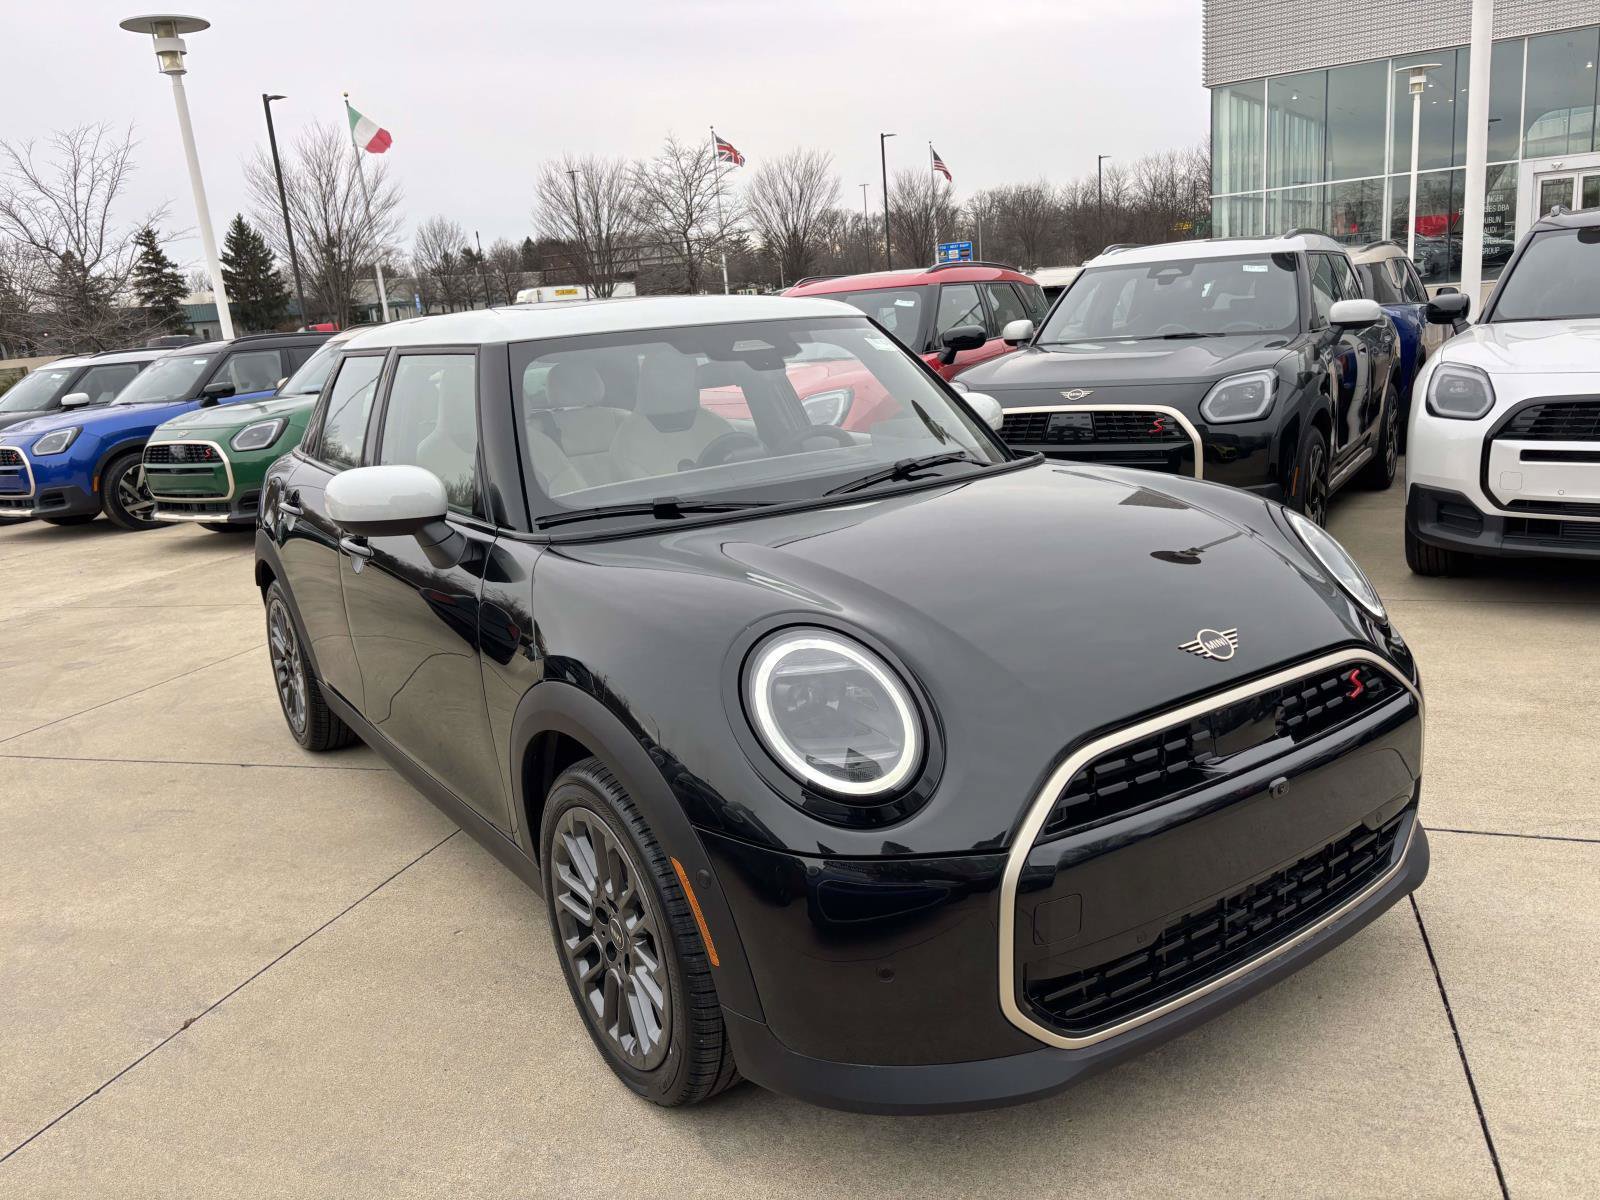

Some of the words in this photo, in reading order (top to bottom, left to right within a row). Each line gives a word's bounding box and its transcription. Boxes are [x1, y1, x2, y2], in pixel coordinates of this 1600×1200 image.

[1497, 204, 1510, 212] DBA
[1484, 216, 1502, 224] UBLIN
[1204, 637, 1228, 650] MINI
[1348, 668, 1363, 699] S
